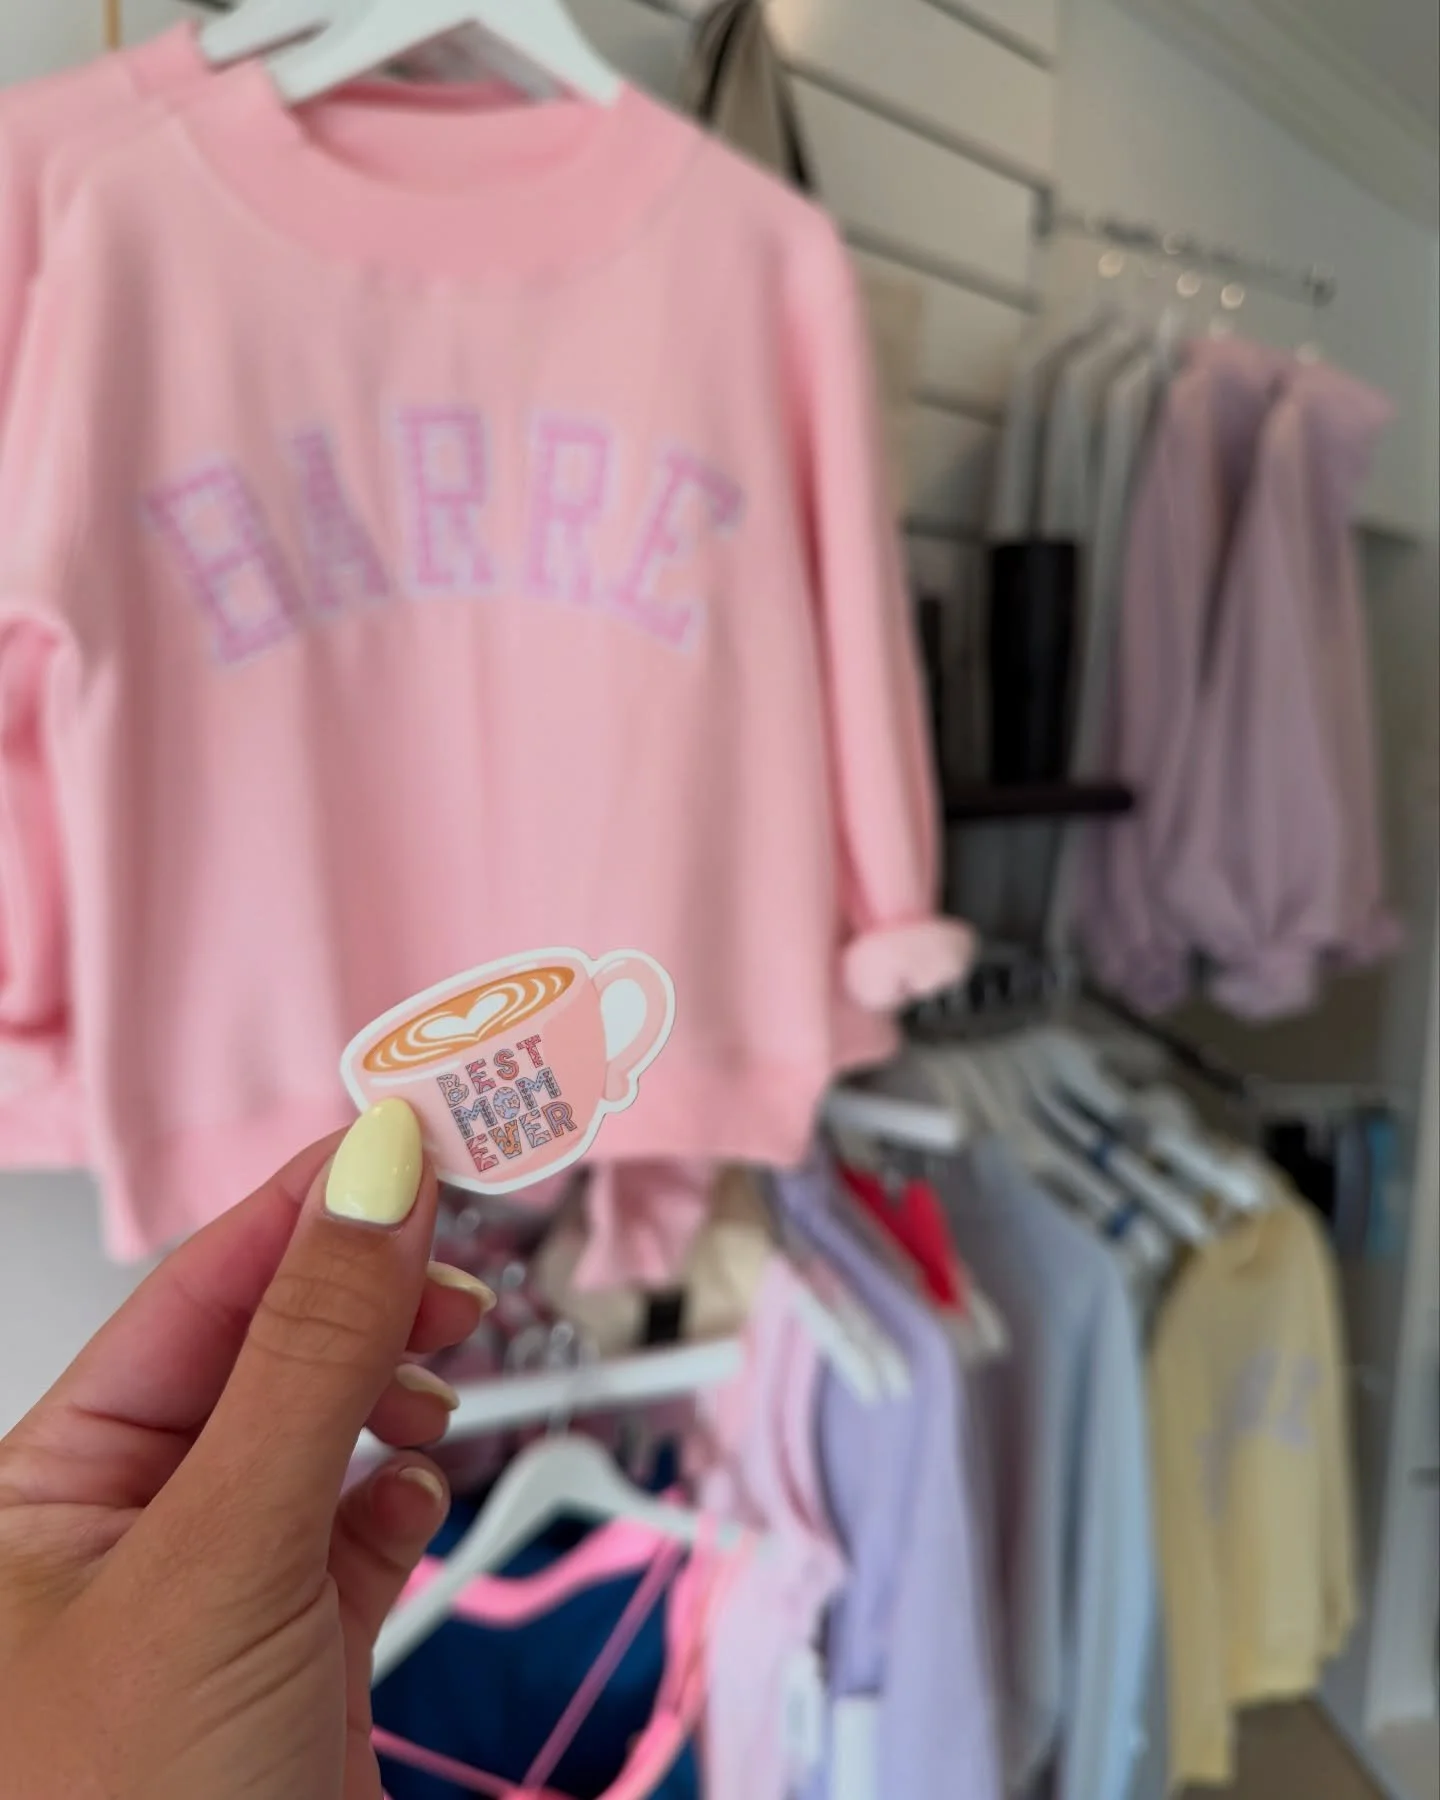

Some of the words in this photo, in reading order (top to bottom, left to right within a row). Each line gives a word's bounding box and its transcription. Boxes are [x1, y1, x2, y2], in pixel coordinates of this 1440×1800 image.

[143, 404, 745, 667] BARRE
[436, 1034, 544, 1108] BEST
[451, 1067, 562, 1140] MOM
[465, 1101, 578, 1173] EVER
